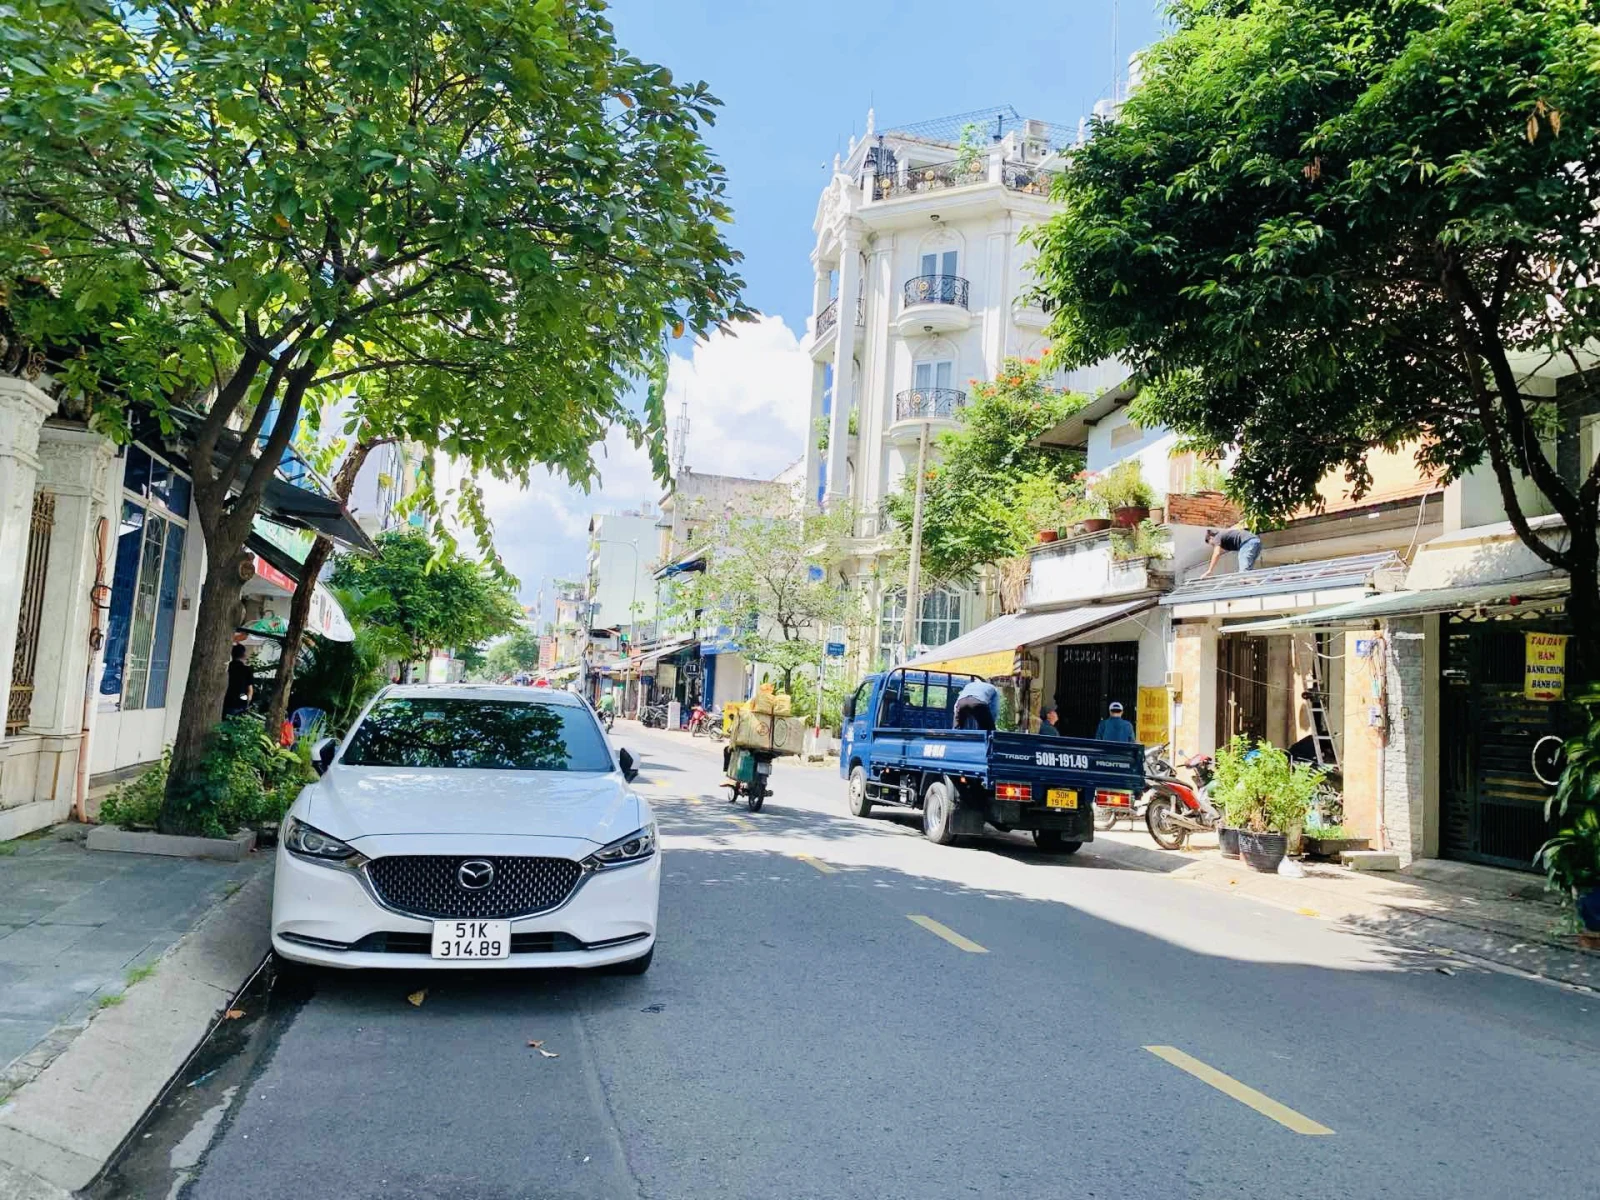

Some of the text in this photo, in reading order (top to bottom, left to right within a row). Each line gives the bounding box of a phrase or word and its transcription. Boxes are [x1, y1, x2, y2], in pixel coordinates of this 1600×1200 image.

[1035, 751, 1089, 769] 50H-191.49
[455, 922, 489, 939] 51K
[440, 940, 501, 957] 314.89
